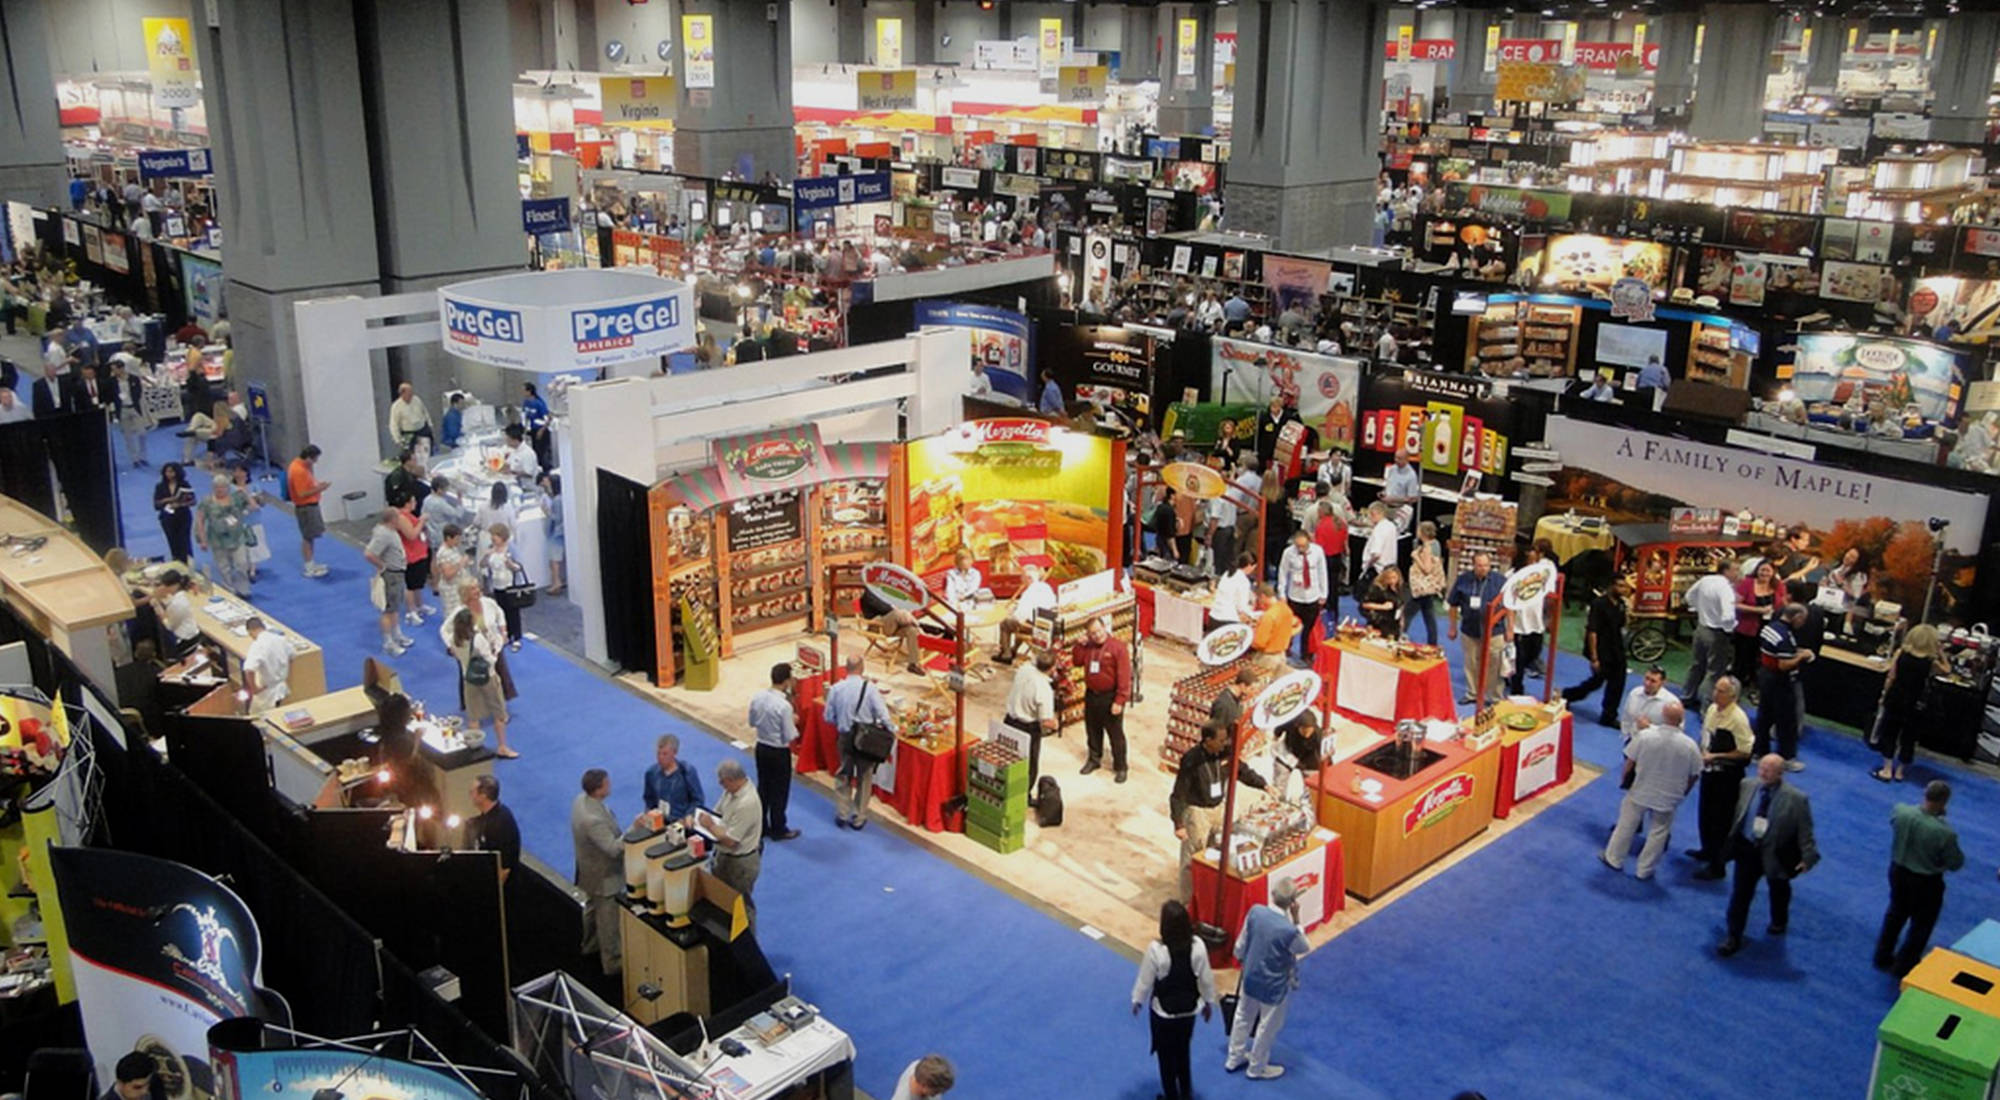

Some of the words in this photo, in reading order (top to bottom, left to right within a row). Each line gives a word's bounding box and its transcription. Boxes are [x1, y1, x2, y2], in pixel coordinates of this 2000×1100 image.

[619, 103, 659, 121] Virginia
[525, 208, 557, 223] Finest
[447, 301, 521, 340] PreGel
[574, 299, 677, 340] PreGel
[579, 337, 633, 351] AMERICA
[1092, 361, 1141, 378] GOURMET
[1403, 370, 1475, 393] BRIANNAS
[1616, 437, 1633, 457] A
[1643, 440, 1730, 473] FAMILY
[1774, 465, 1872, 504] MAPLE!
